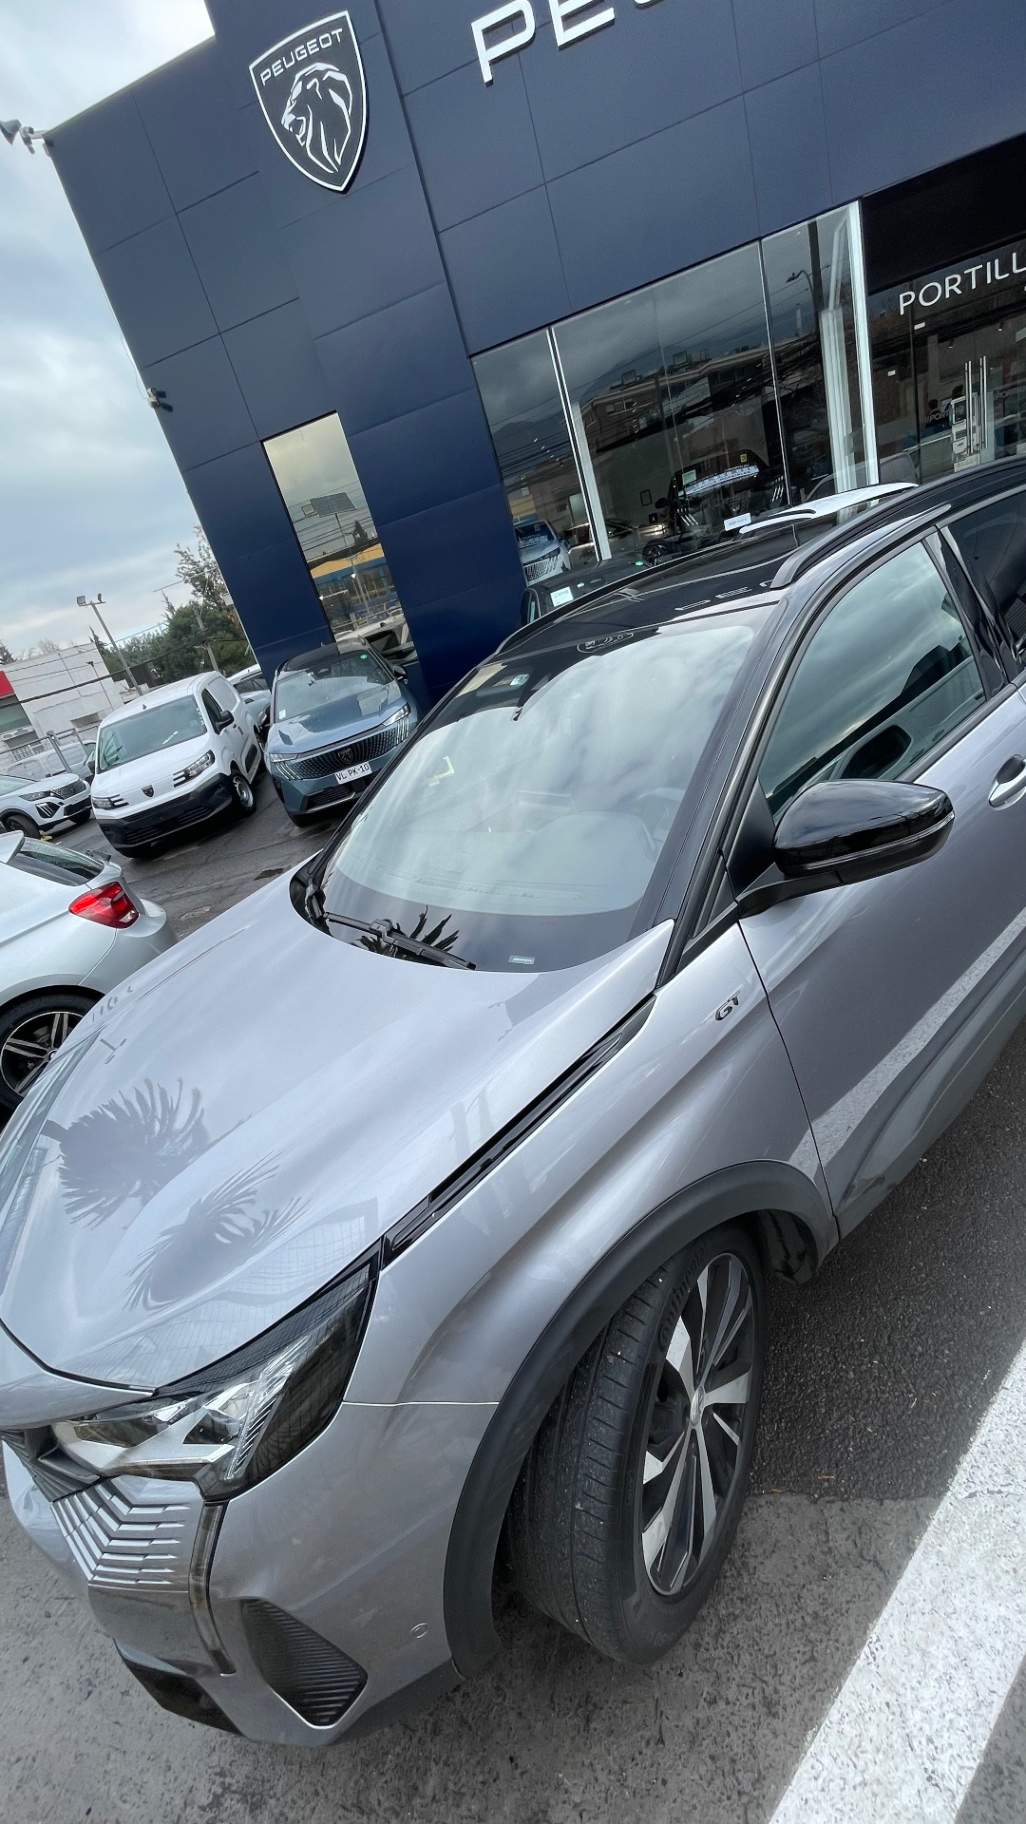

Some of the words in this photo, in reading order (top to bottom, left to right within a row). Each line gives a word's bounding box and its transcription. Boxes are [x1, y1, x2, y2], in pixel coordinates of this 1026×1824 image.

[260, 28, 343, 86] PEUGEOT
[899, 252, 1026, 316] PORTILL
[715, 990, 740, 1021] GT
